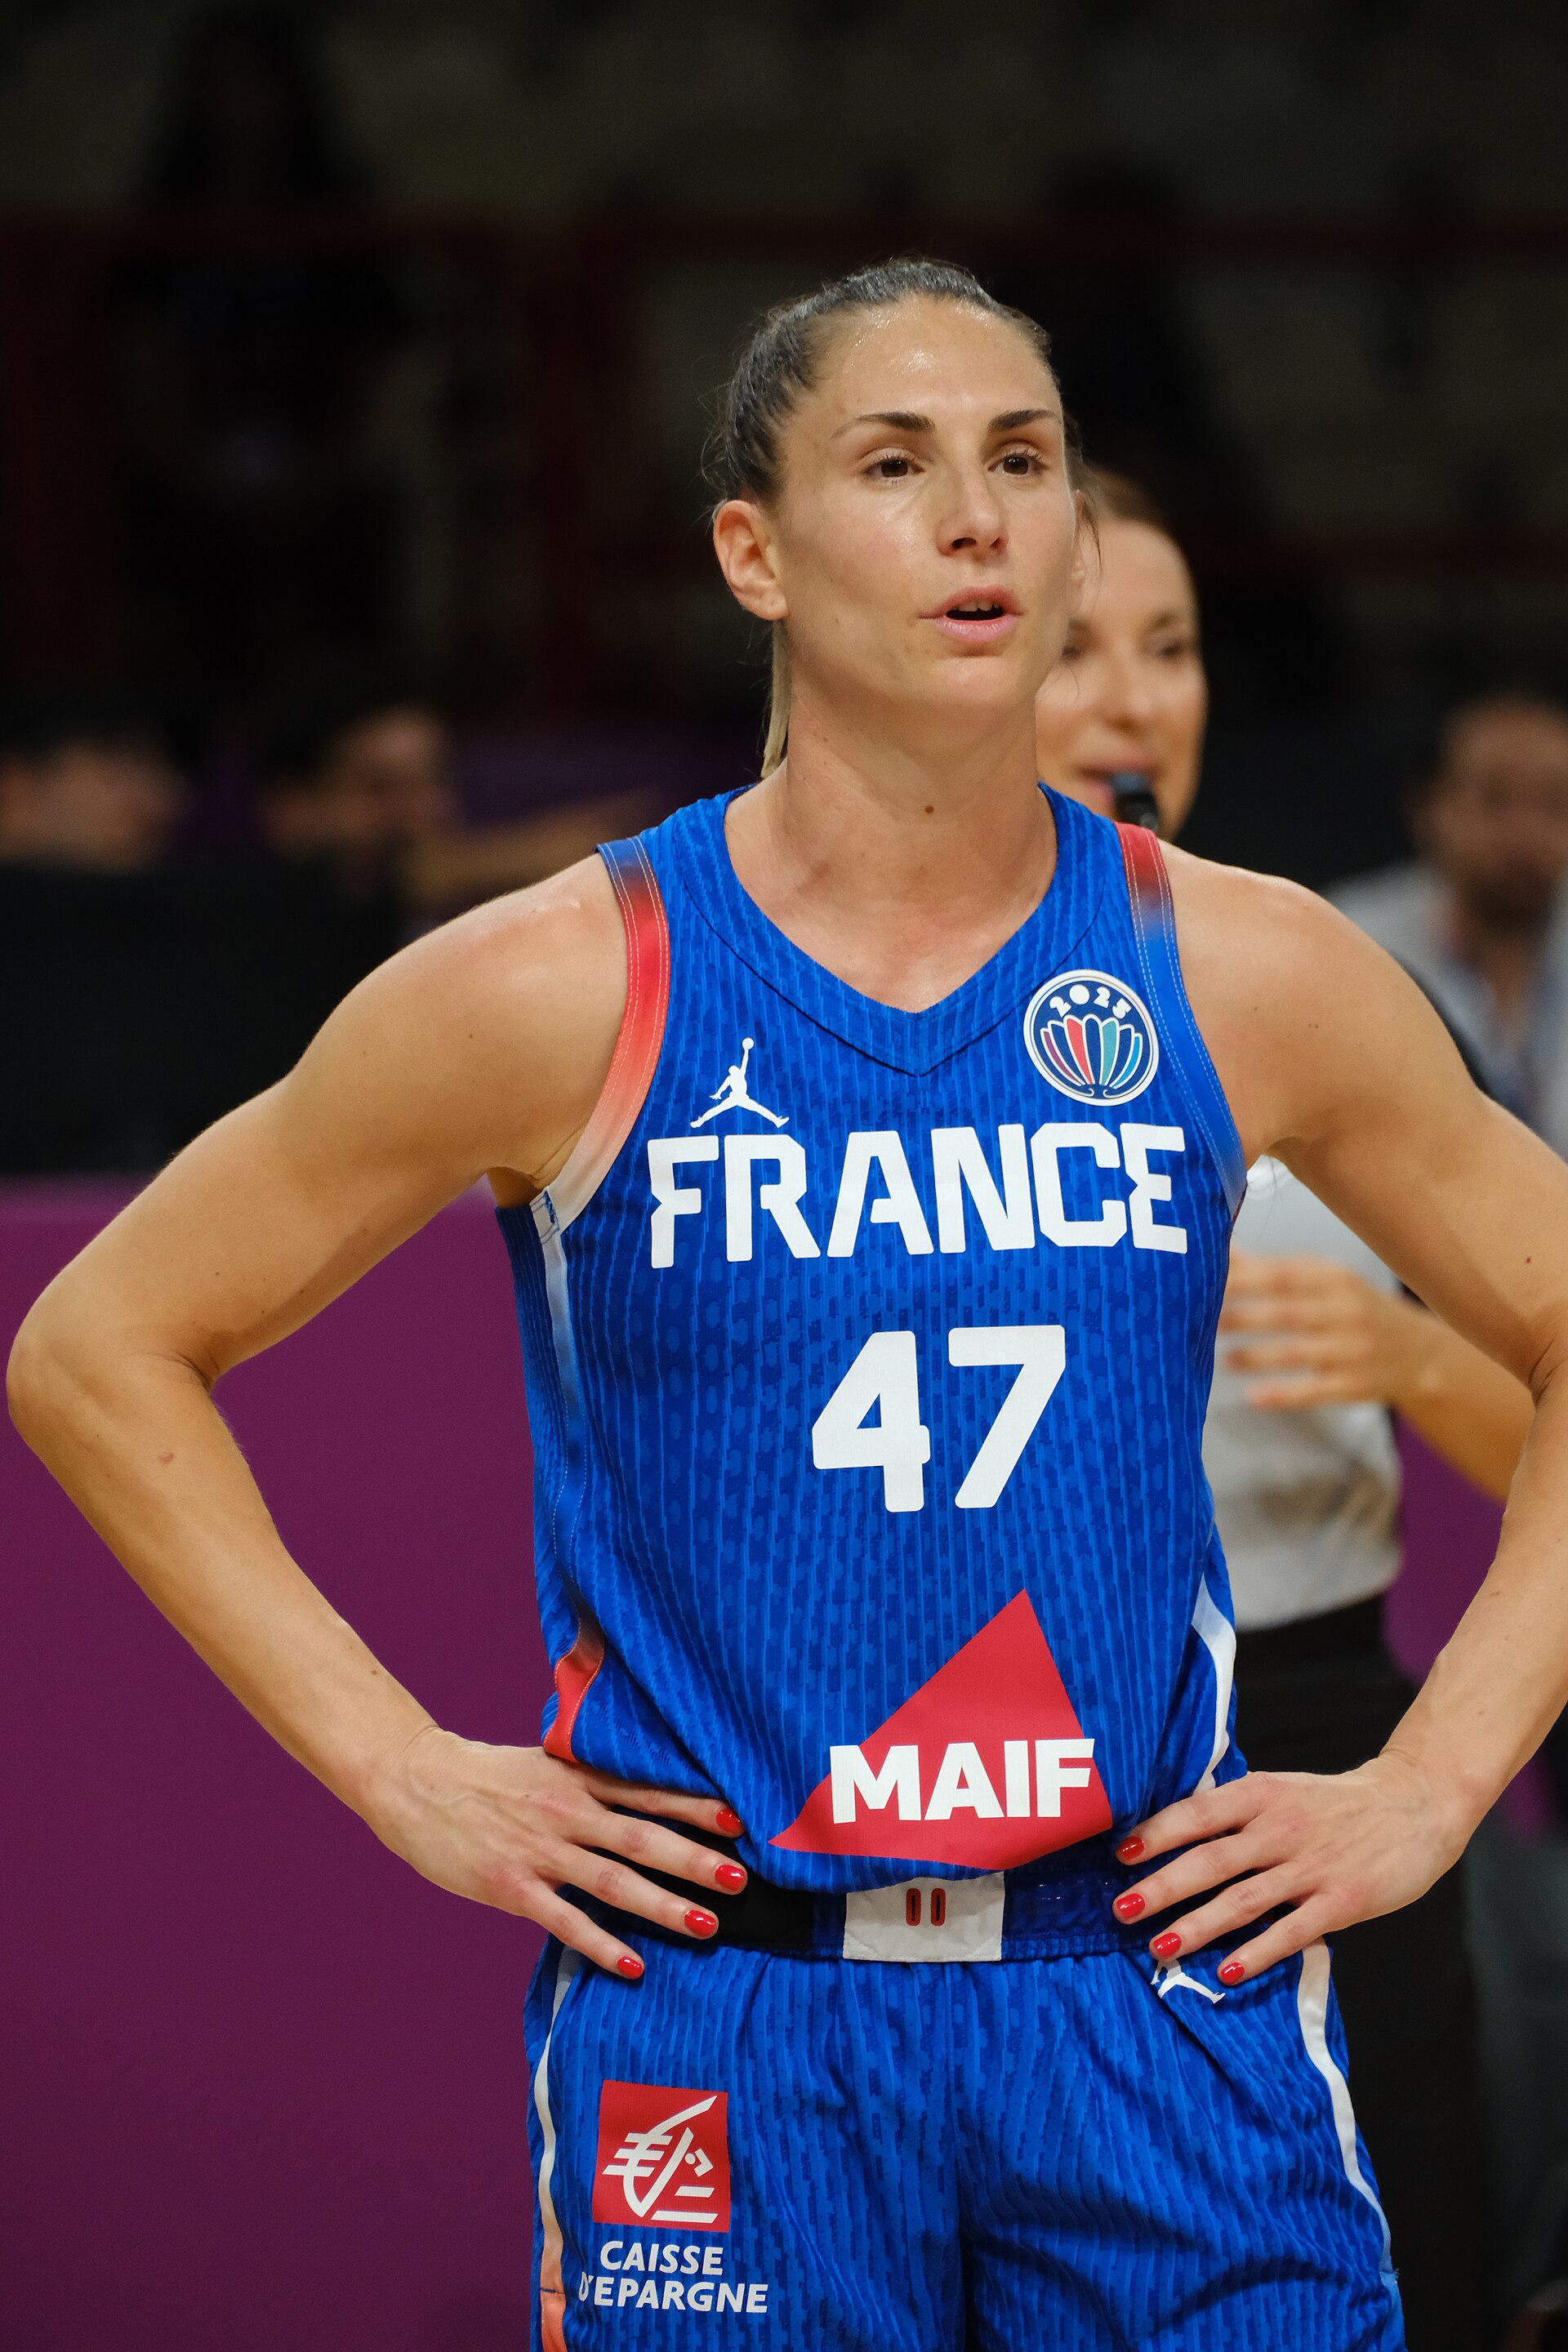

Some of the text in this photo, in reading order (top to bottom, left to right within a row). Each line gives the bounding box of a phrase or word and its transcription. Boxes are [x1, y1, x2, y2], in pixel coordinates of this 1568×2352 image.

[1049, 984, 1132, 1019] 2025
[648, 1122, 1187, 1268] FRANCE
[812, 1325, 1065, 1512] 47
[830, 1738, 1095, 1824] MAIF
[600, 2241, 724, 2275] CAISSE
